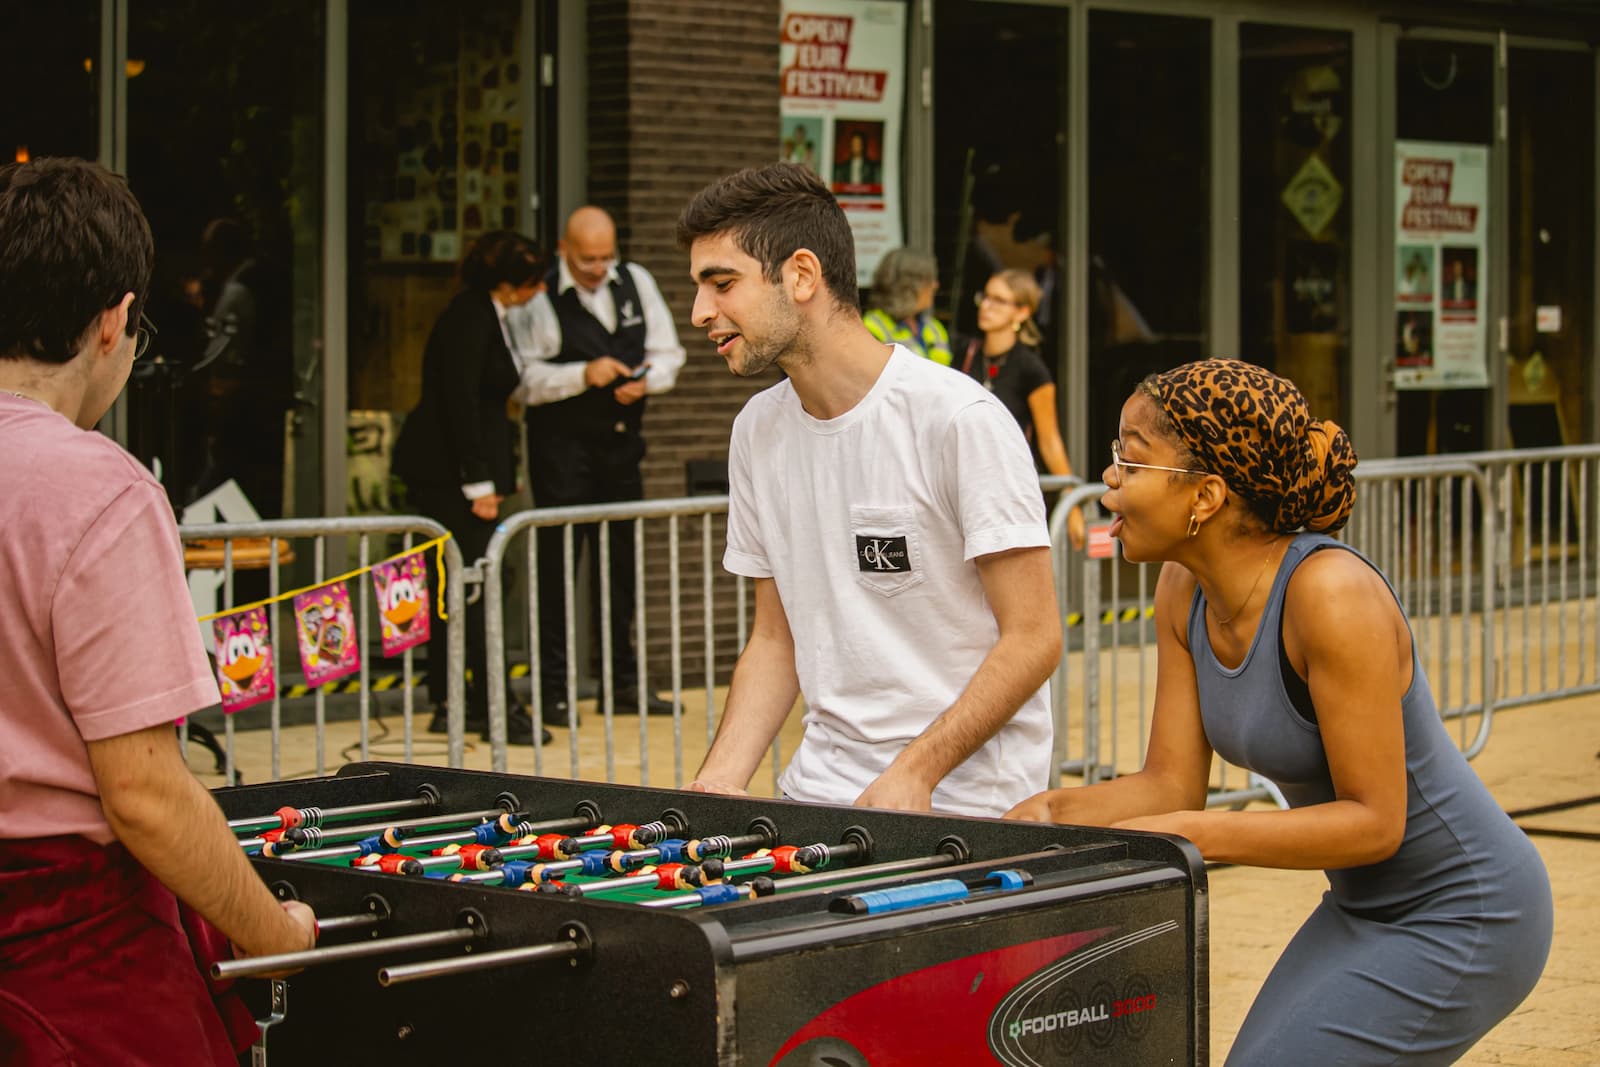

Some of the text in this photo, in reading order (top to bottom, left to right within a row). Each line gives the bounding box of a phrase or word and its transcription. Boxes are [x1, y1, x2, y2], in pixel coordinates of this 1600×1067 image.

[786, 16, 848, 43] OPEN
[785, 69, 881, 99] FESTIVAL
[1022, 993, 1157, 1036] FOOTBALL 3000
